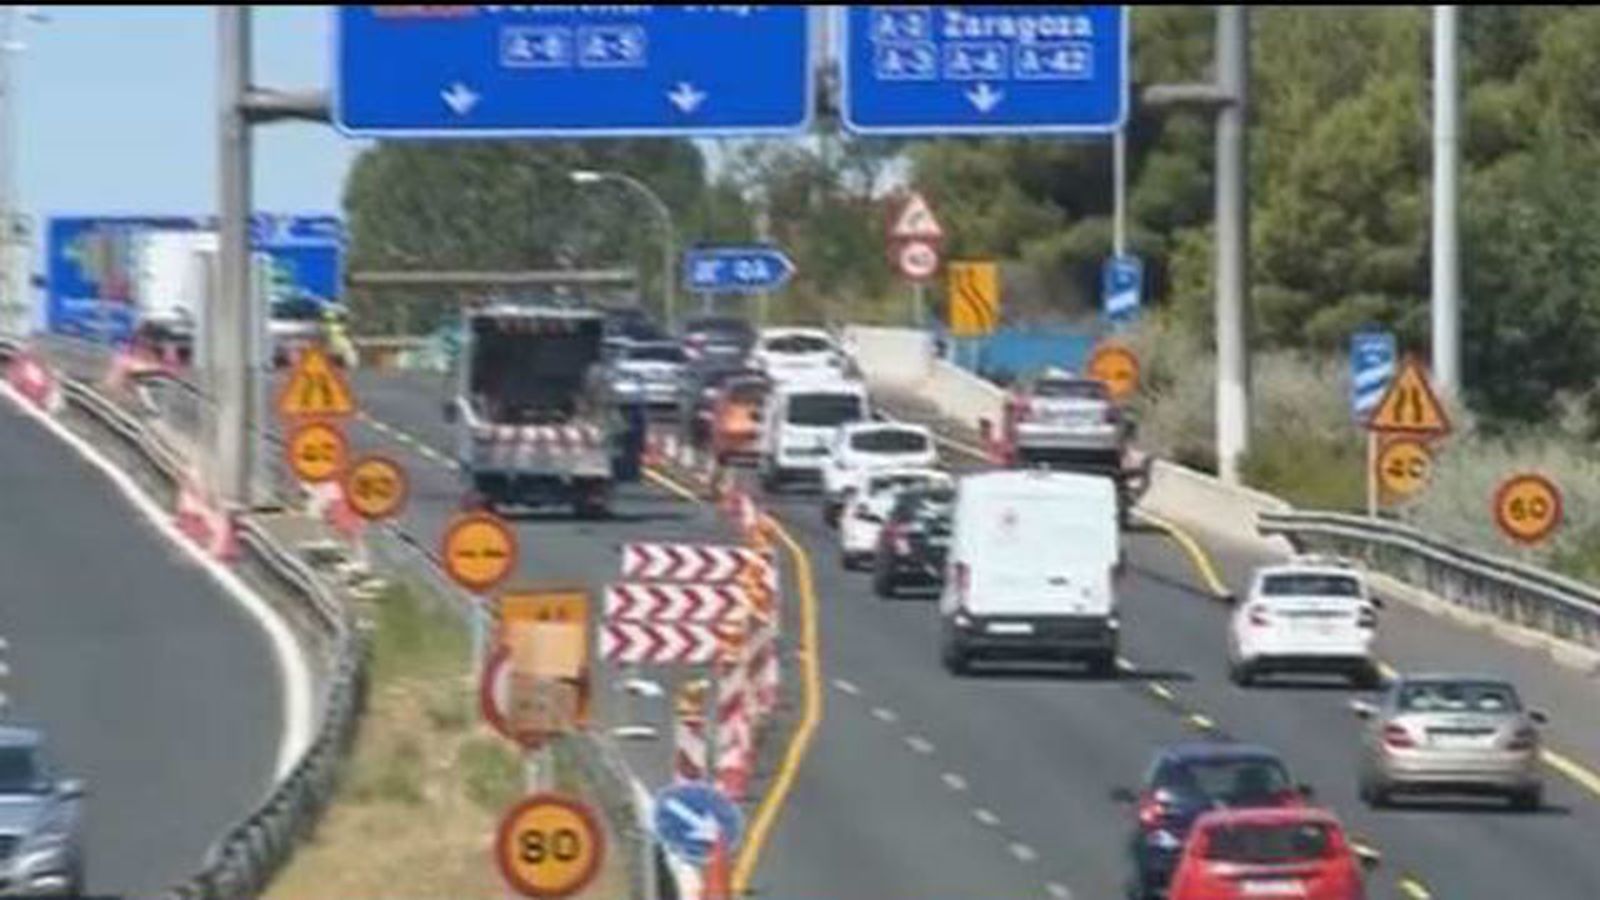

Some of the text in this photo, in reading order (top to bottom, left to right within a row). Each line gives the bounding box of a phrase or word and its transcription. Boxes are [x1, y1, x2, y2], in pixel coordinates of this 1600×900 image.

[943, 9, 1093, 44] Zaragoza
[1386, 457, 1425, 478] 40
[1510, 496, 1548, 520] 60
[519, 829, 580, 864] 80
